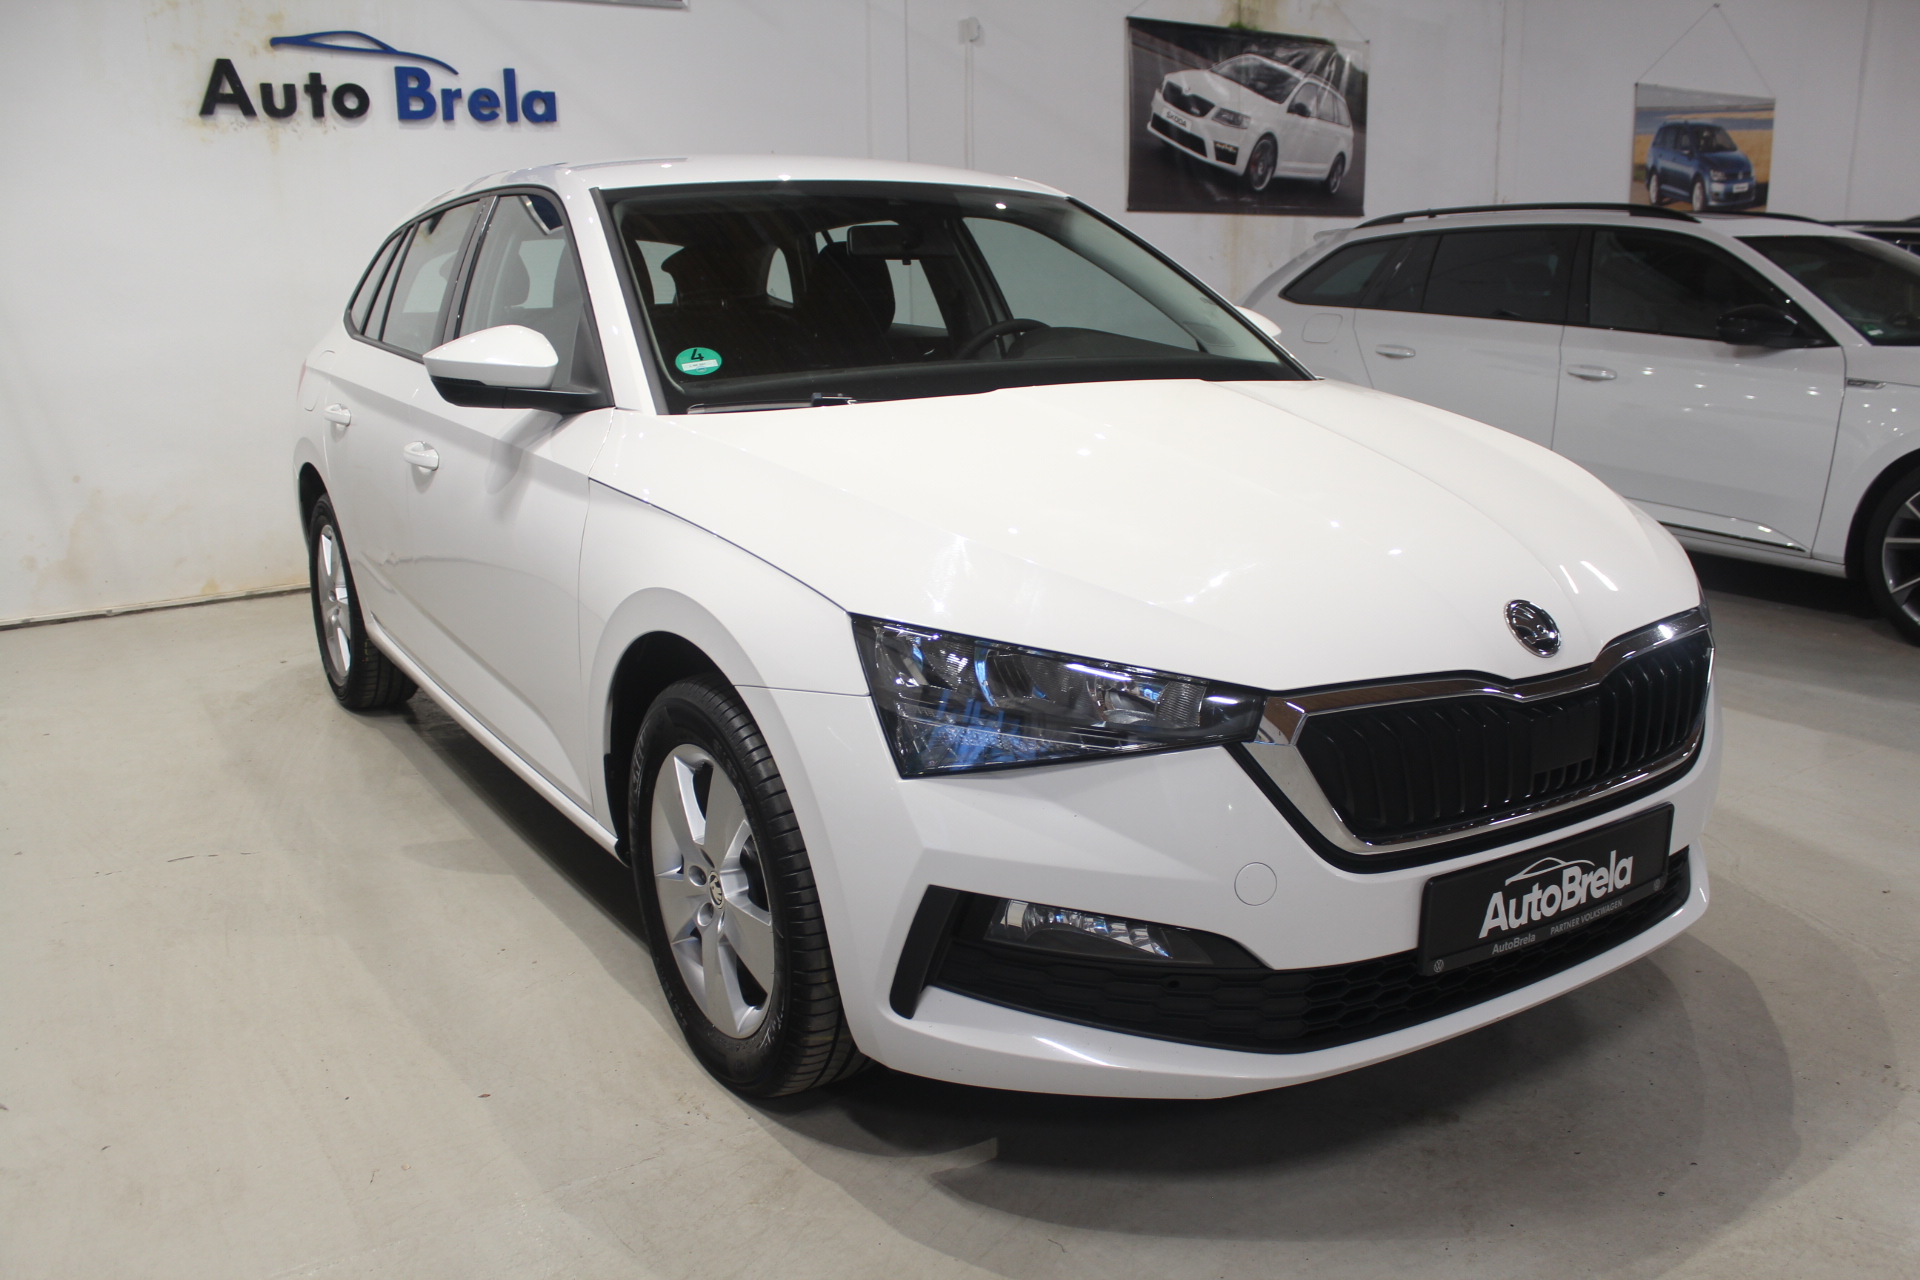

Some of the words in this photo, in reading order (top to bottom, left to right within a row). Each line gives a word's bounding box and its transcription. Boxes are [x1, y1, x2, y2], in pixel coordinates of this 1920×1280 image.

[199, 58, 370, 118] Auto
[394, 66, 557, 122] Brela
[691, 348, 704, 361] 4
[1479, 850, 1633, 939] AutoBrela
[1492, 933, 1536, 955] AutoBrela
[1550, 916, 1580, 935] PARTNER
[1580, 899, 1622, 923] VOLKSWAGEN
